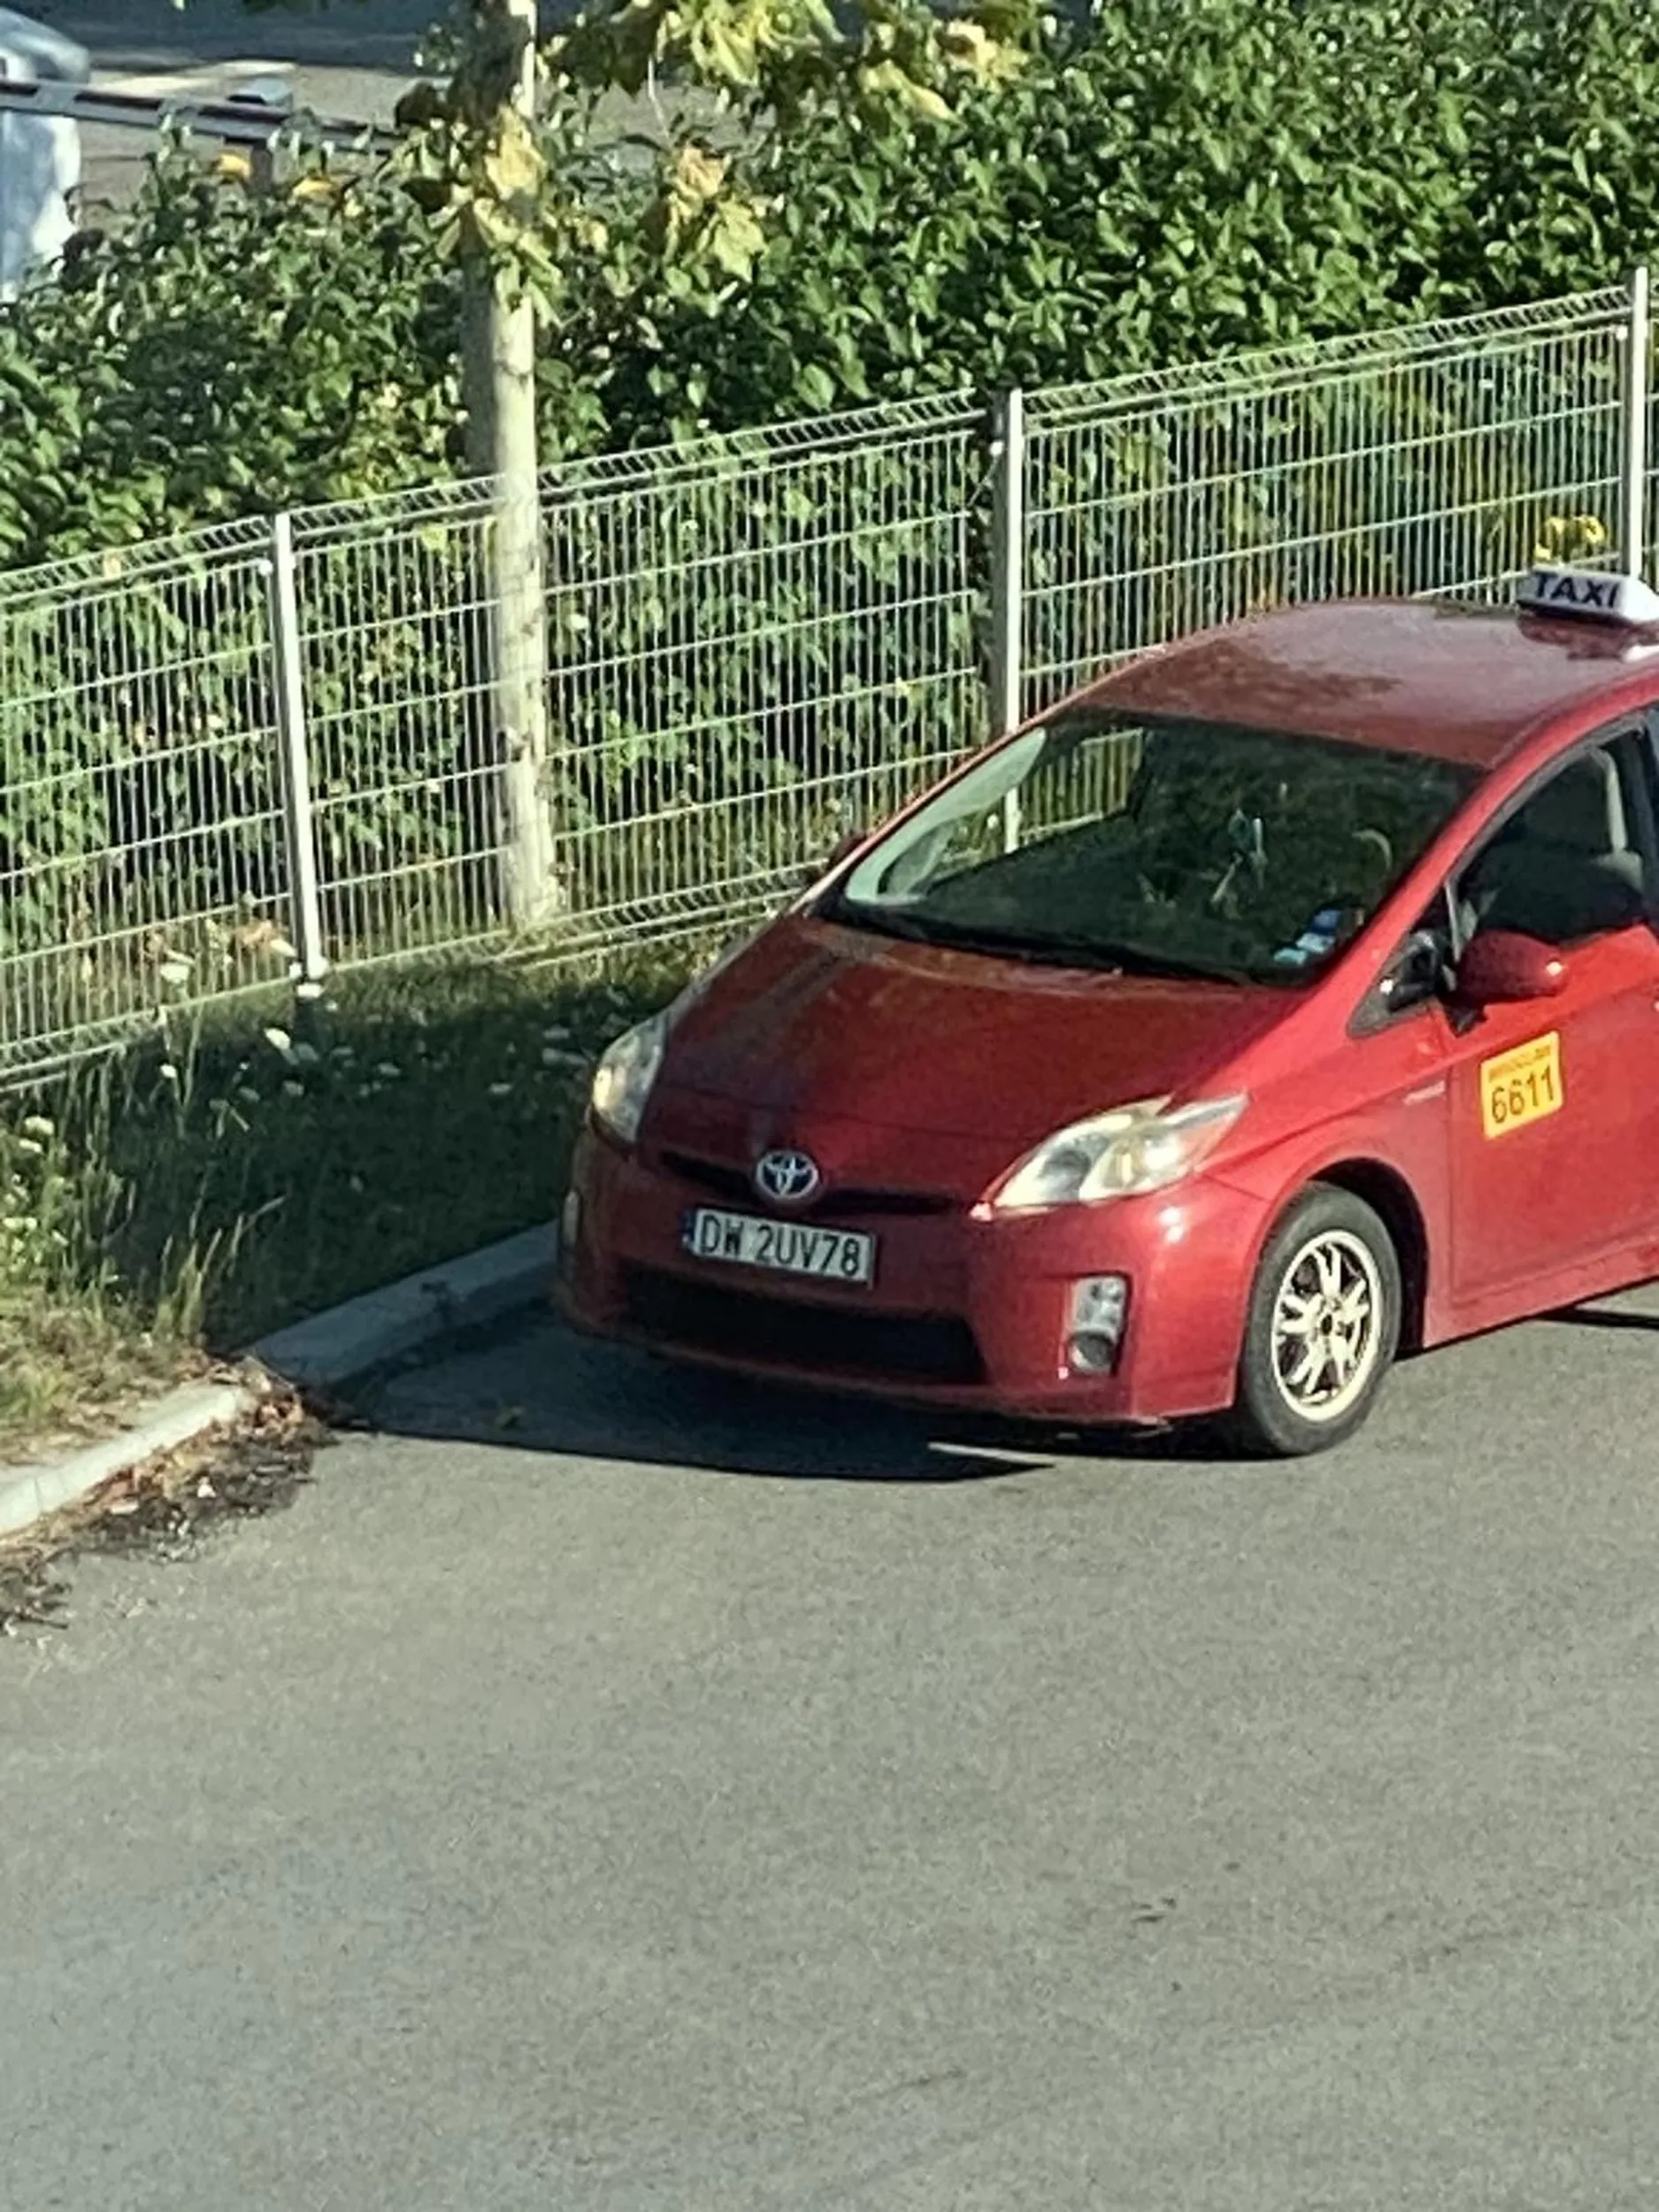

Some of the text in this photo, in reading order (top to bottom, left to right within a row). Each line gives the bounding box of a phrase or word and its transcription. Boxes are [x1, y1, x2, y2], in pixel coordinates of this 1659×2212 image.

[1534, 572, 1619, 608] TAXI
[1492, 1064, 1554, 1124] 6611
[701, 1214, 860, 1277] DW 2UV78
